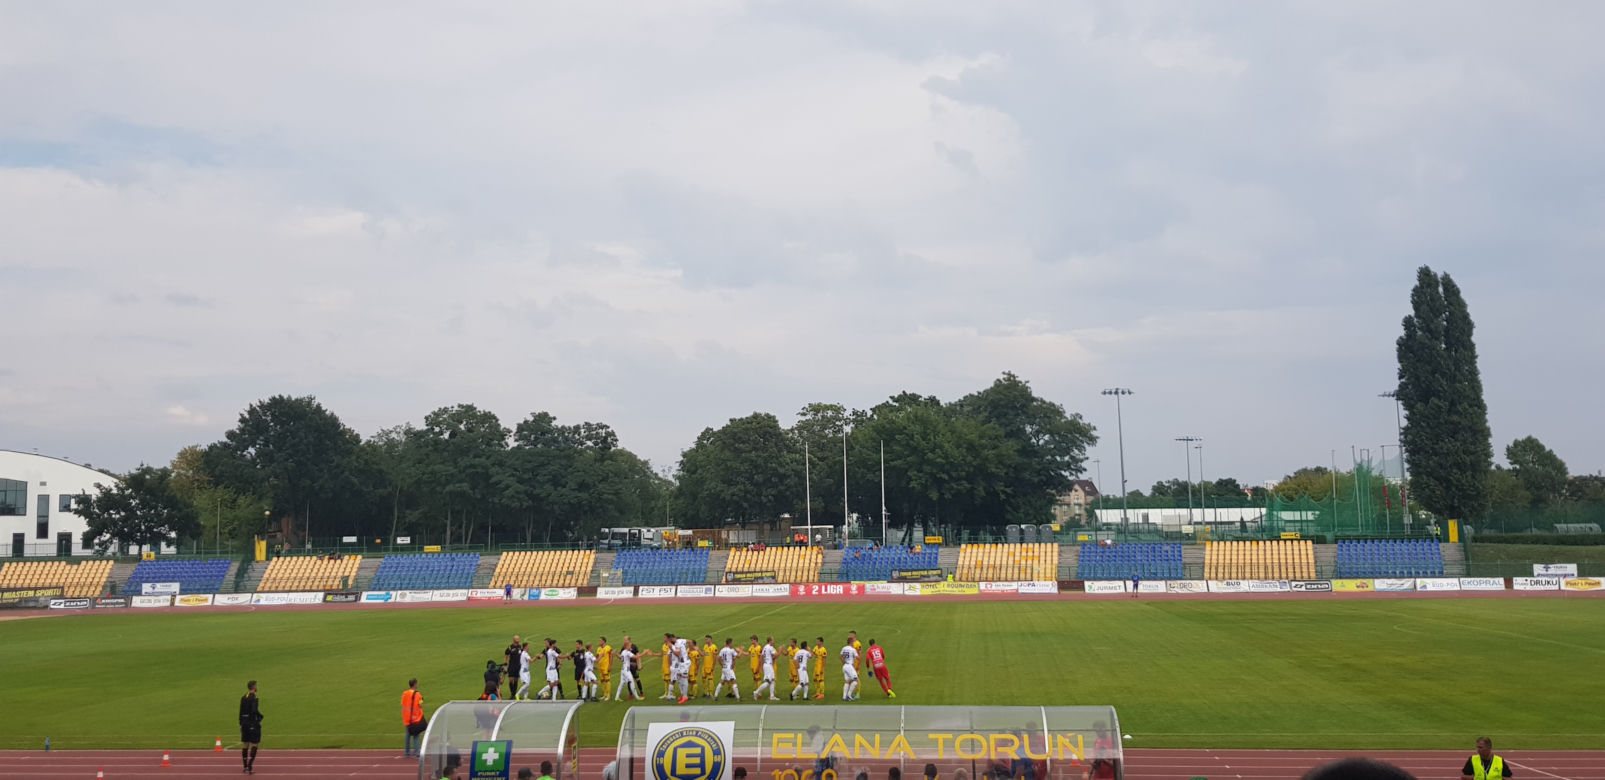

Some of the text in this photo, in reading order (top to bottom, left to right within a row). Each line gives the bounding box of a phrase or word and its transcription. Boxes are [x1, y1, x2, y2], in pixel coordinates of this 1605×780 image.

[1461, 579, 1504, 587] EKOPRAL
[1529, 579, 1558, 587] DRUKU
[35, 588, 62, 597] SPORTU
[812, 584, 844, 594] 2 LIGA
[871, 649, 882, 660] 15
[771, 732, 1086, 761] ELANA TORUŃ
[675, 746, 702, 775] E
